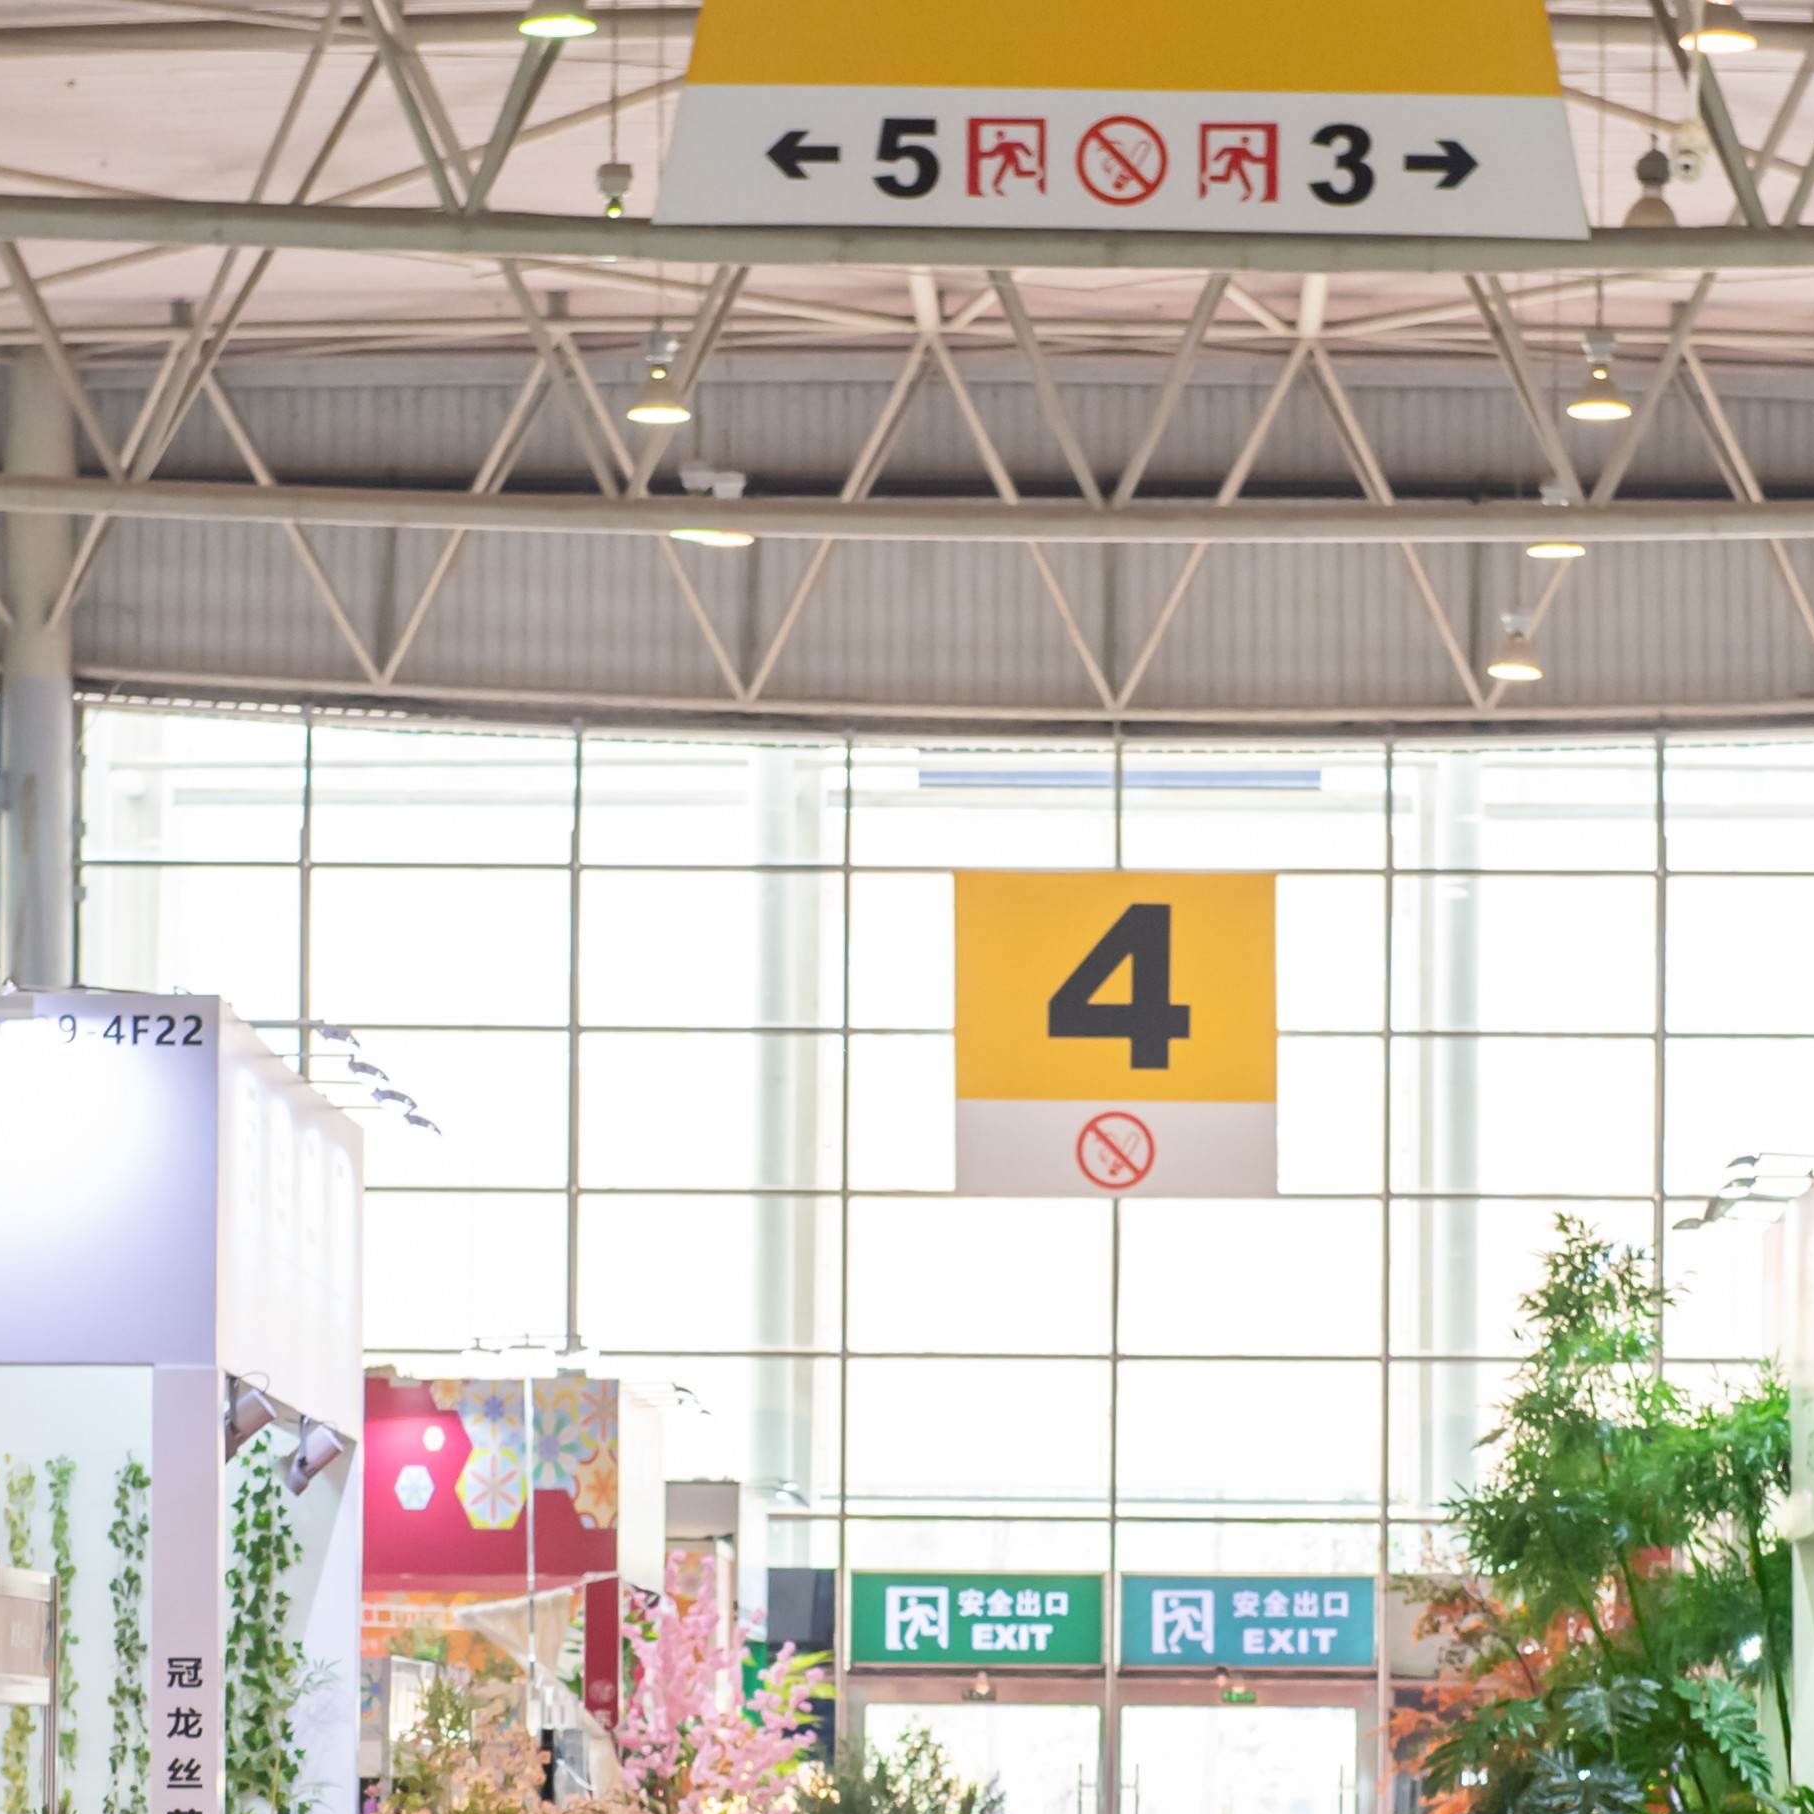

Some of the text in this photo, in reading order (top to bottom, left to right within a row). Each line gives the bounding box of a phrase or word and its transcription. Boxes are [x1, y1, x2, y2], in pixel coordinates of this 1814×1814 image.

[872, 117, 1375, 206] 5 3
[1048, 903, 1190, 1069] 4
[958, 1589, 1069, 1618] 安全出口
[1232, 1590, 1350, 1619] 安全出口
[971, 1623, 1054, 1652] EXIT
[1242, 1628, 1338, 1655] EXIT
